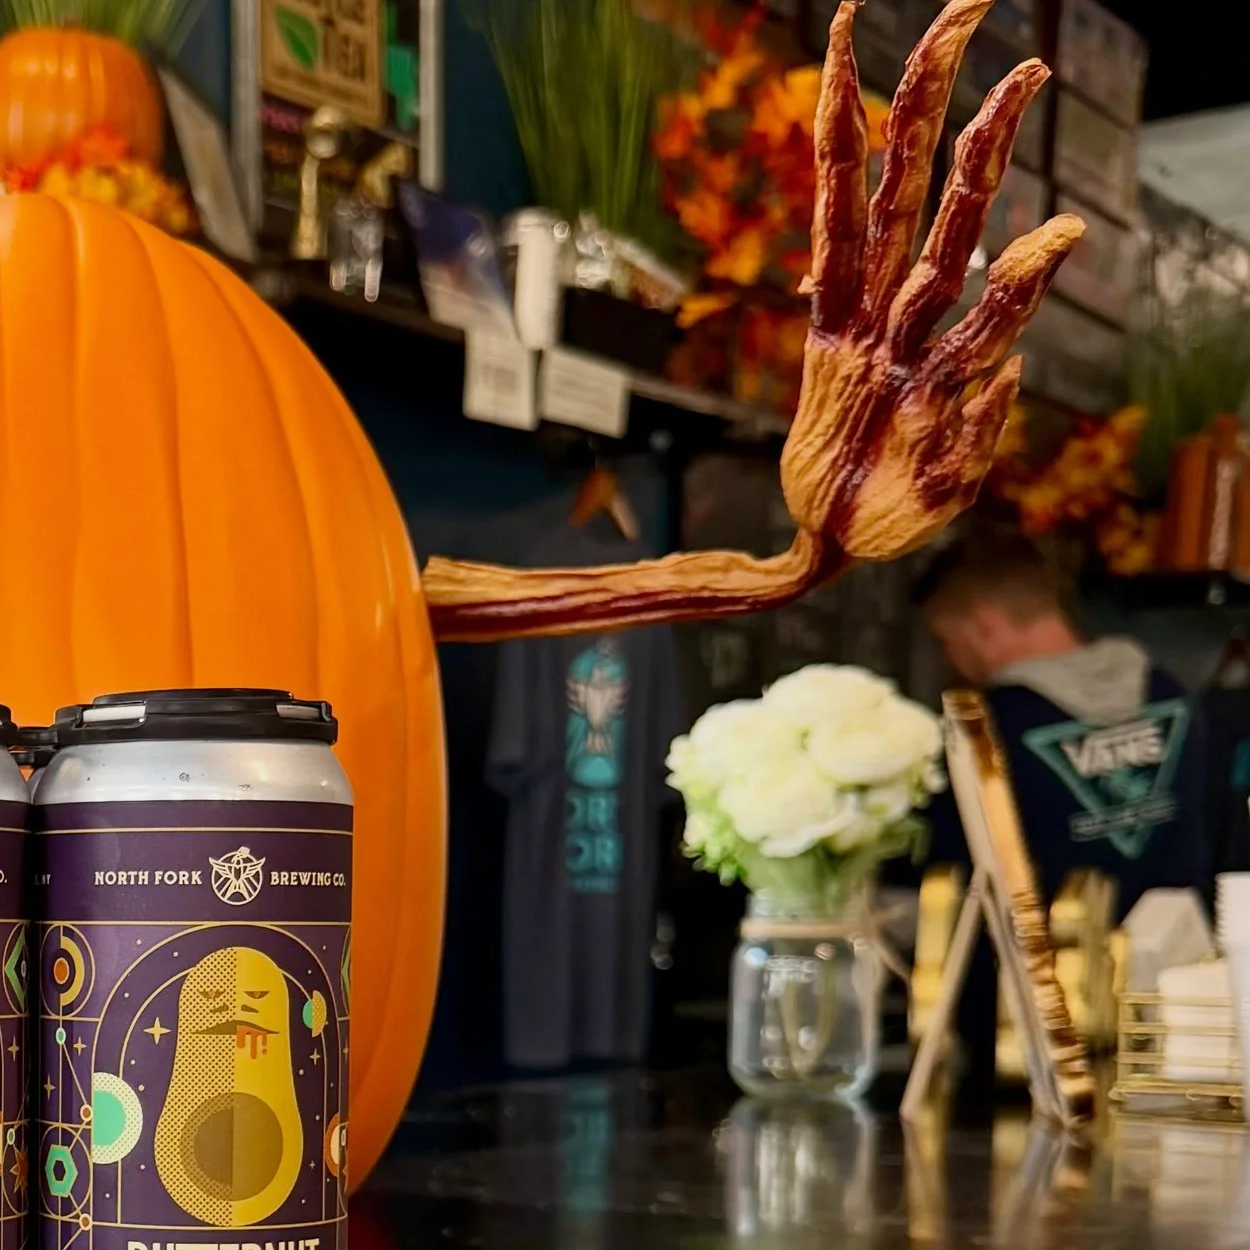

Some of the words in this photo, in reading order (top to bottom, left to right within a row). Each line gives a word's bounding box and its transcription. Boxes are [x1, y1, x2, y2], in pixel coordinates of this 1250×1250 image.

[94, 870, 149, 886] NORTH
[154, 870, 203, 885] FORK
[270, 871, 331, 886] BREWING
[332, 872, 346, 887] CO.
